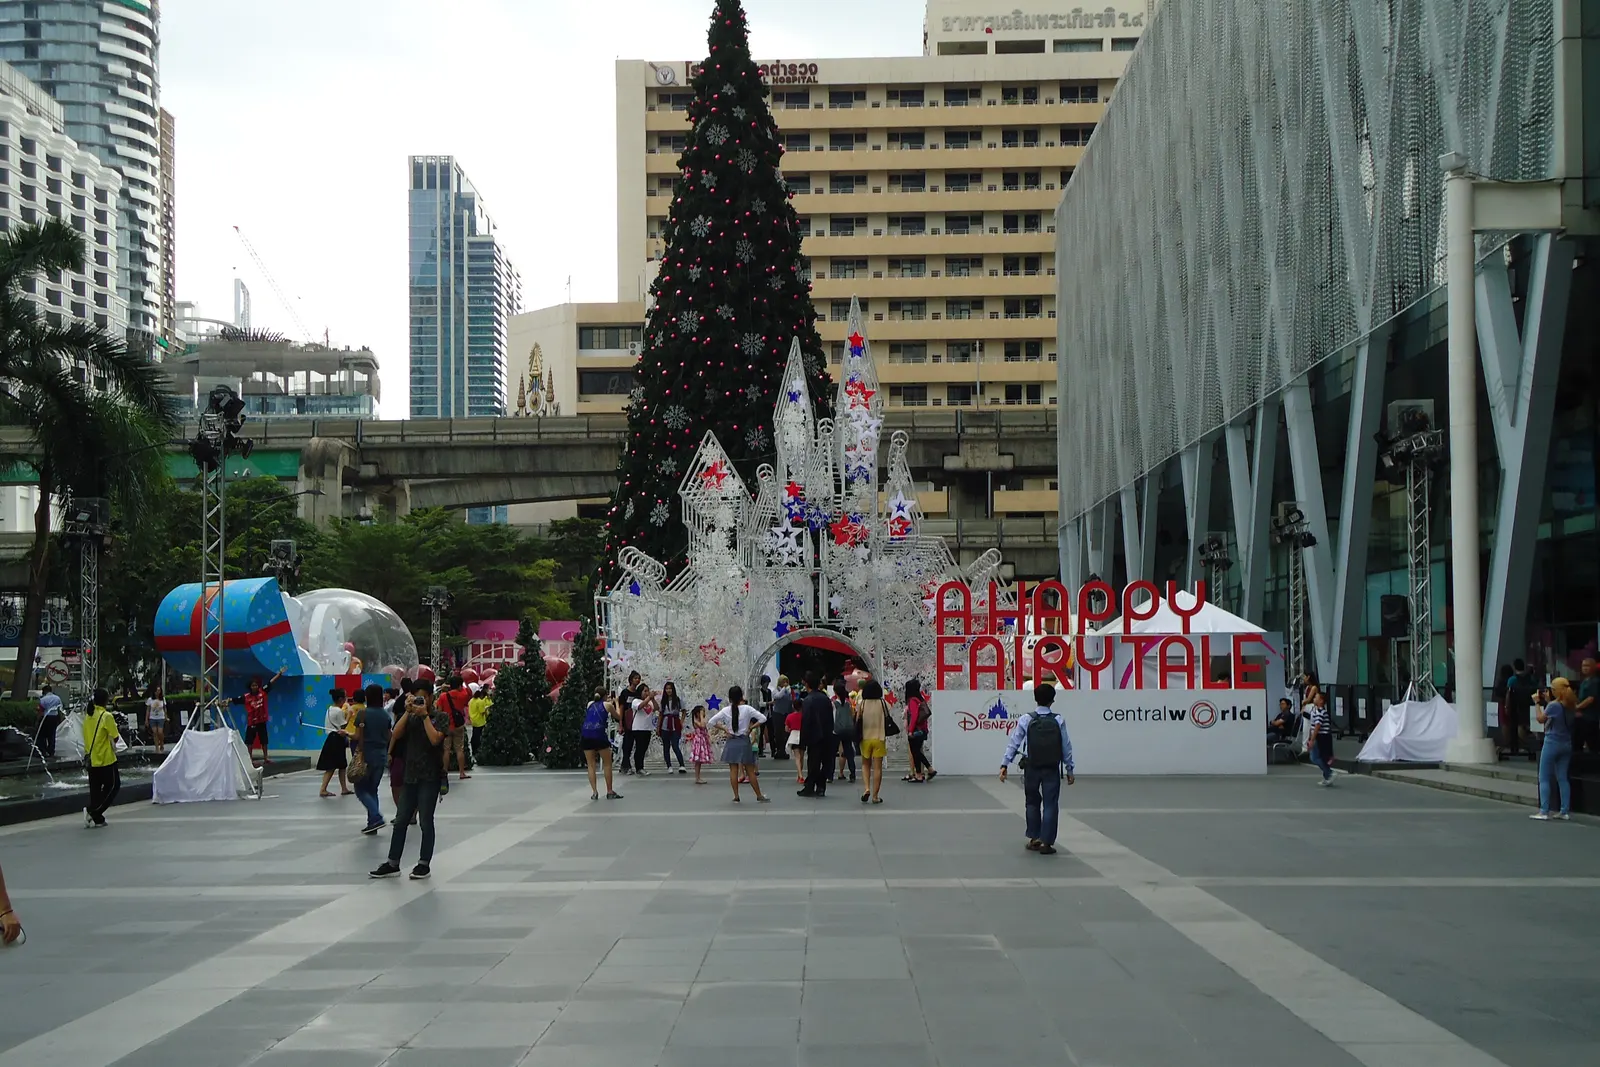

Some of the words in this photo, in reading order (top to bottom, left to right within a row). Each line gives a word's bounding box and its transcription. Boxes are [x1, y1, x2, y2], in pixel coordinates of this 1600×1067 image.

[772, 75, 819, 84] HOSPITAL
[936, 580, 973, 635] A
[988, 580, 1206, 635] HAPPY
[1102, 699, 1252, 729] centralworld
